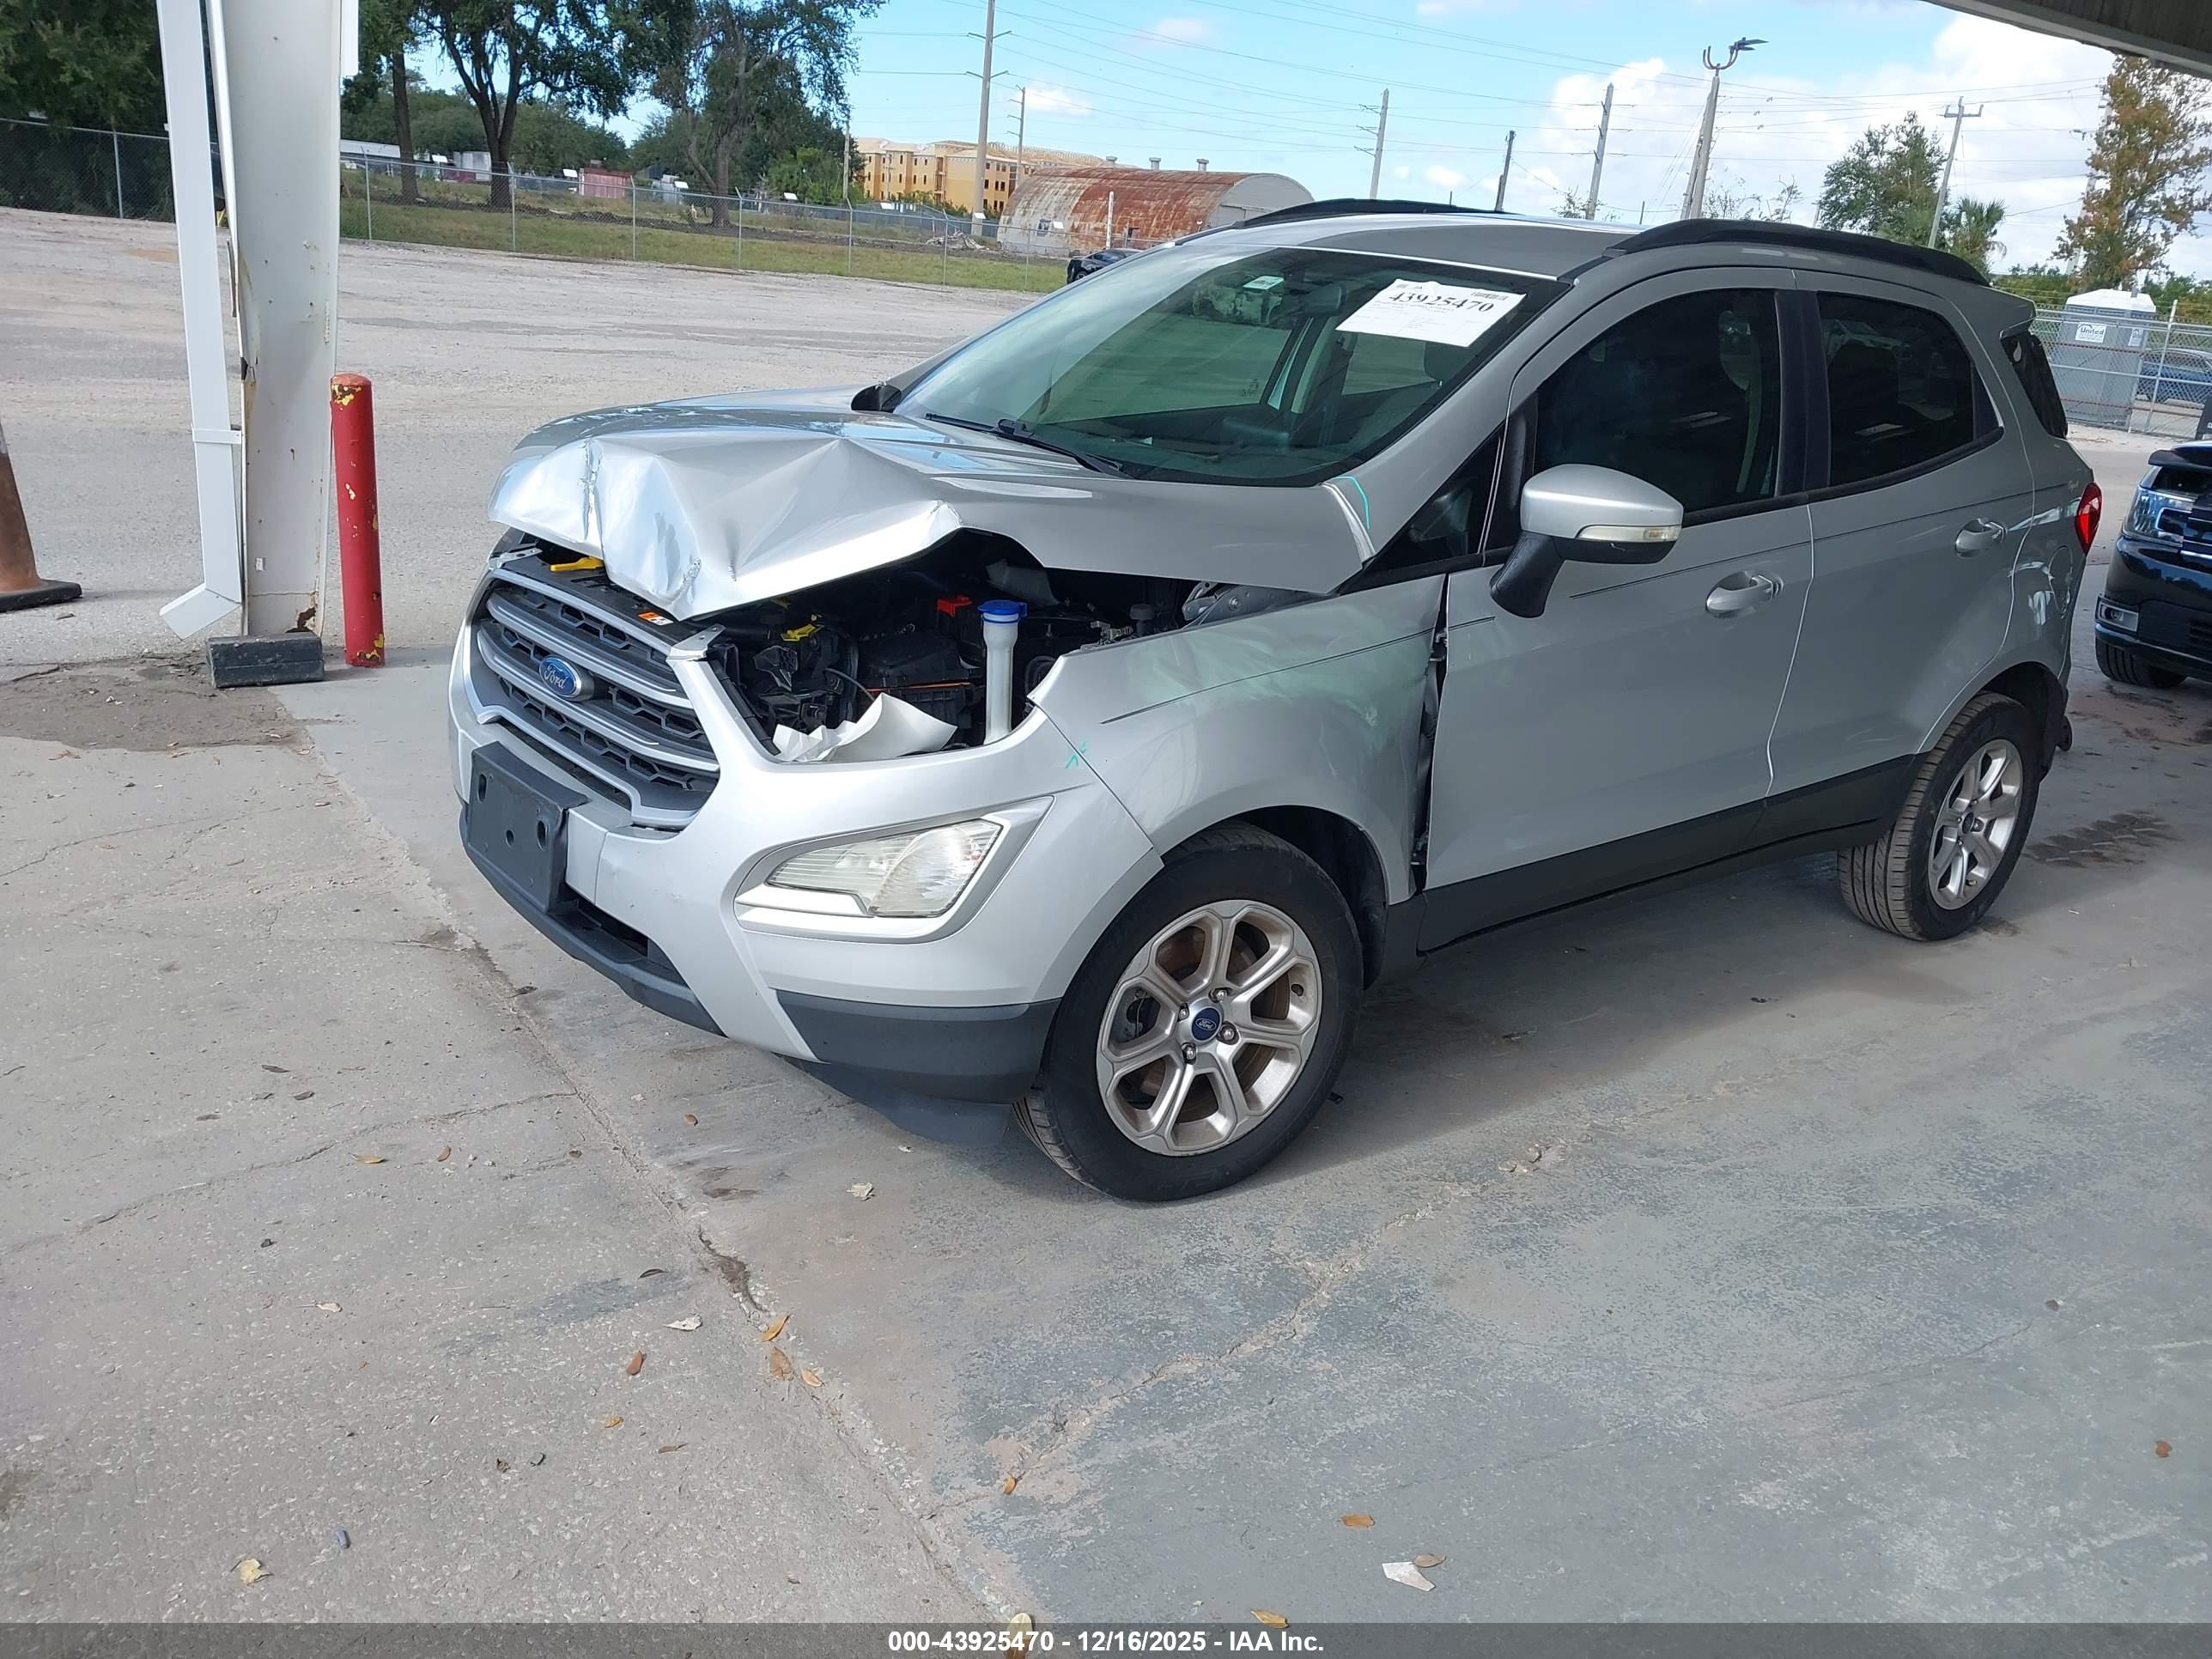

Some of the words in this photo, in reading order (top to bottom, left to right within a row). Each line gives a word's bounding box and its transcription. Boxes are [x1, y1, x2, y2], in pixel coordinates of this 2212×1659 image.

[1389, 291, 1495, 313] 43925470
[544, 664, 568, 690] Ford
[1198, 1019, 1213, 1029] Ford
